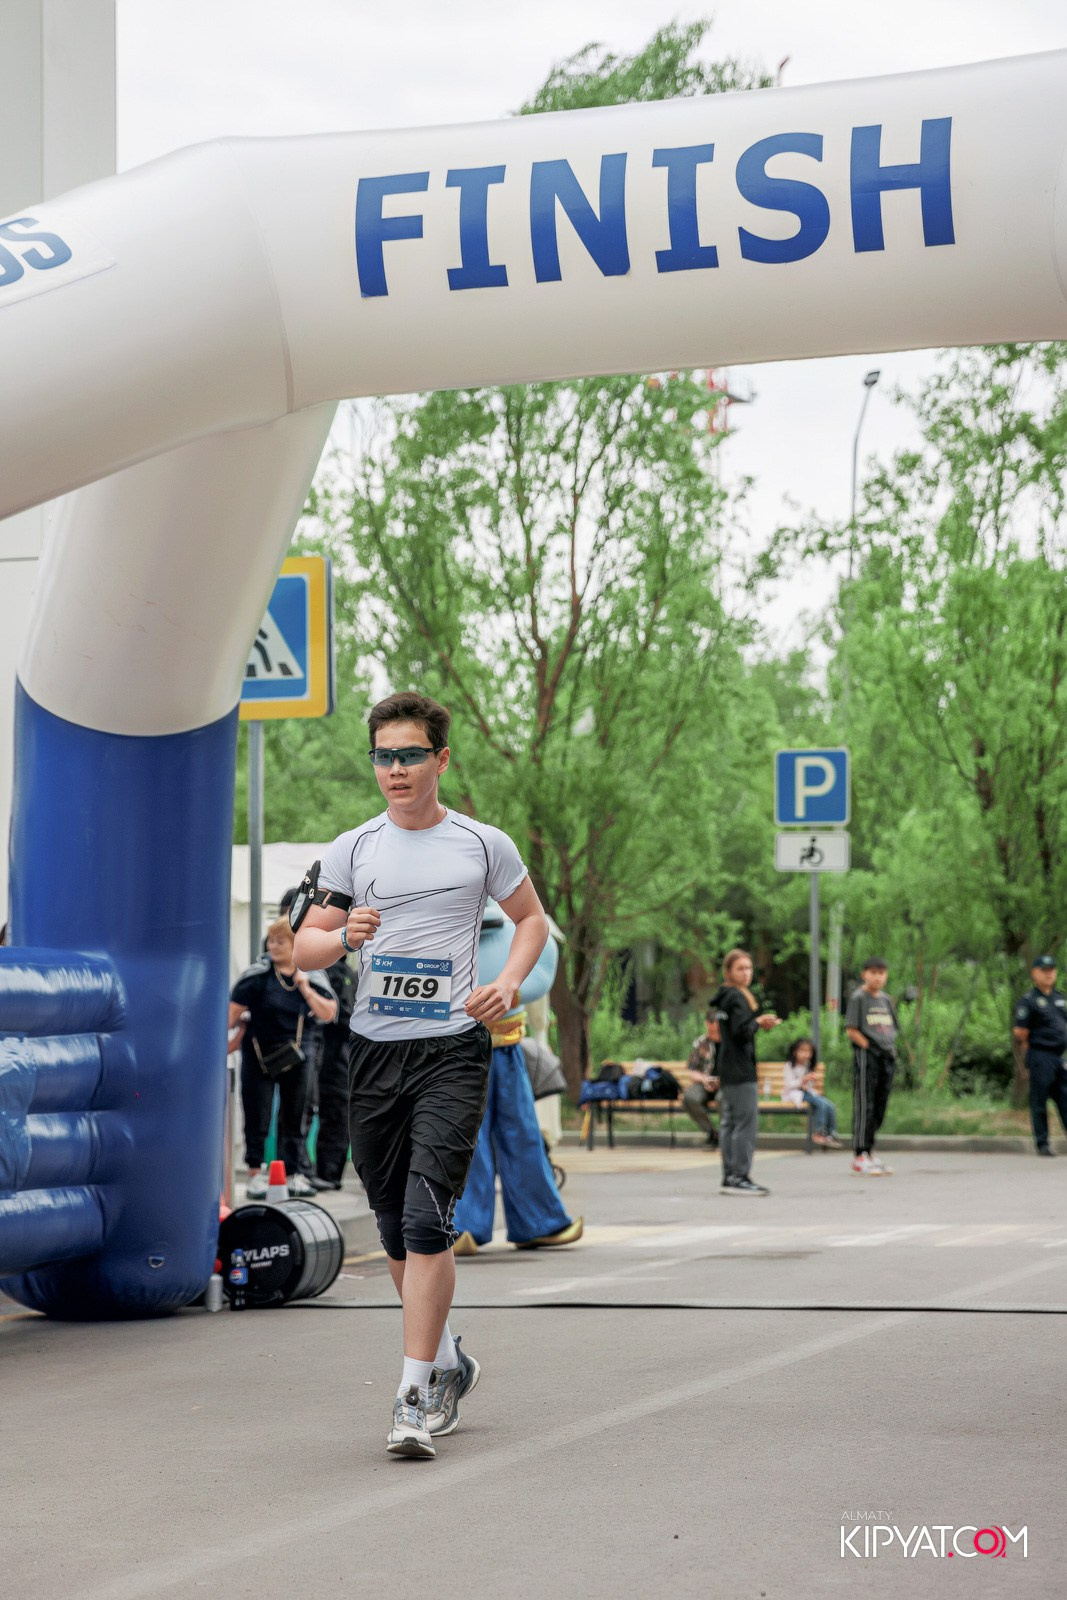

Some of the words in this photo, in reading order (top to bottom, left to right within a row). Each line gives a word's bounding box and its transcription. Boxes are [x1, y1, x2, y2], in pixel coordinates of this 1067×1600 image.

[356, 116, 955, 298] FINISH
[794, 756, 837, 819] P
[382, 975, 439, 999] 1169
